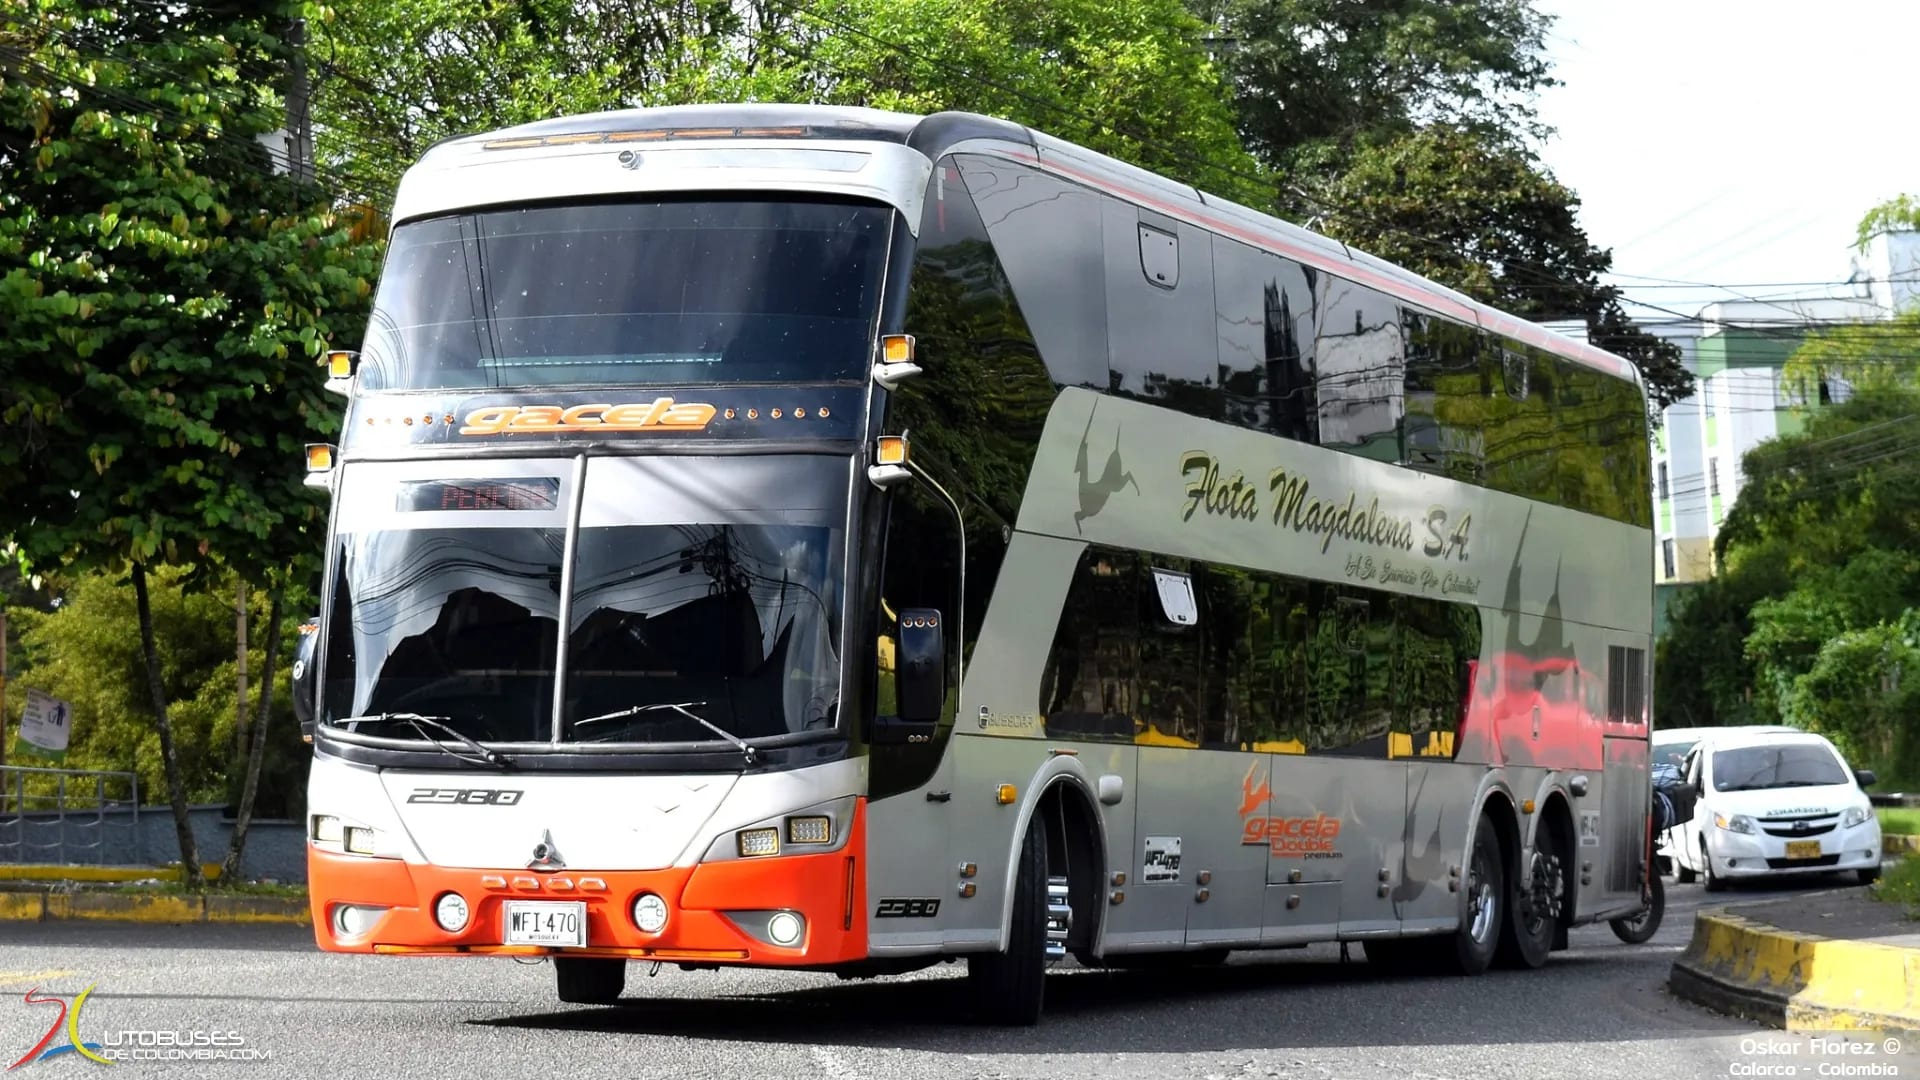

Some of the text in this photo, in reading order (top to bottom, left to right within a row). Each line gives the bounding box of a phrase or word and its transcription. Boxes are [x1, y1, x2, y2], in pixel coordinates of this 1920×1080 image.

[460, 398, 716, 434] gacela
[1181, 450, 1259, 522] Flota
[1268, 465, 1414, 555] Magdalena
[1242, 810, 1342, 842] gacela
[1271, 837, 1334, 851] Double
[1303, 852, 1343, 860] premium
[875, 899, 941, 918] 2380
